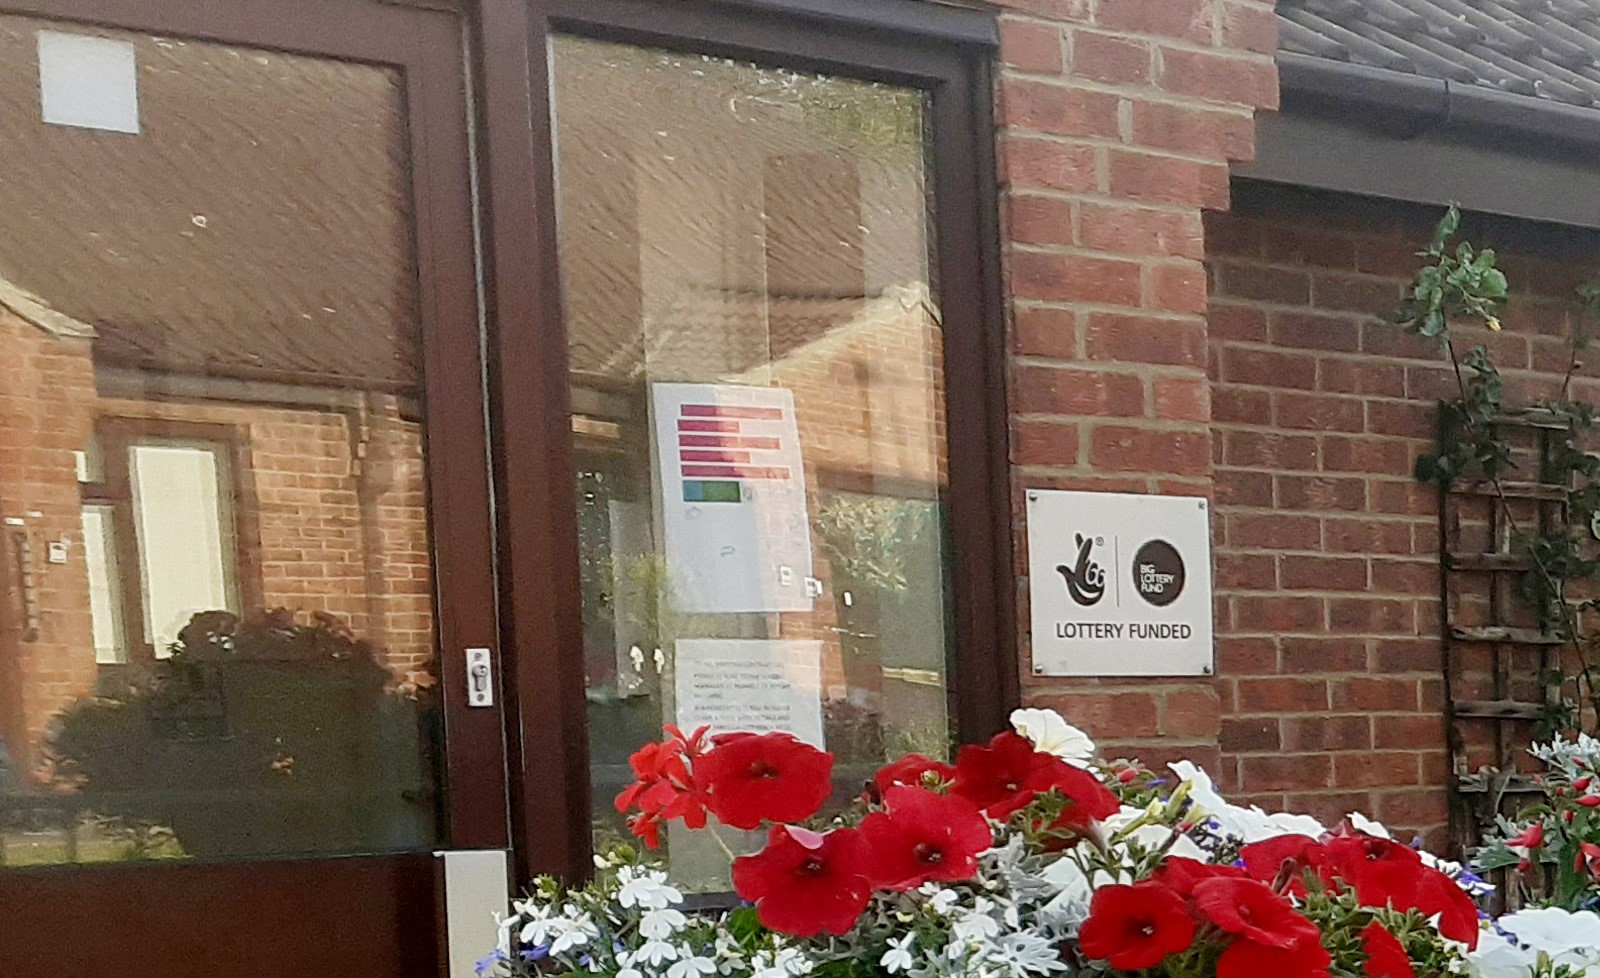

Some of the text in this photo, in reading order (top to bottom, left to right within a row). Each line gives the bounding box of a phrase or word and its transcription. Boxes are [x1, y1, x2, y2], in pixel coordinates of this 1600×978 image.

[1140, 564, 1155, 574] BIG
[1141, 573, 1175, 584] LOTTERY
[1141, 583, 1164, 593] FUND
[1056, 622, 1191, 640] LOTTERY FUNDED
